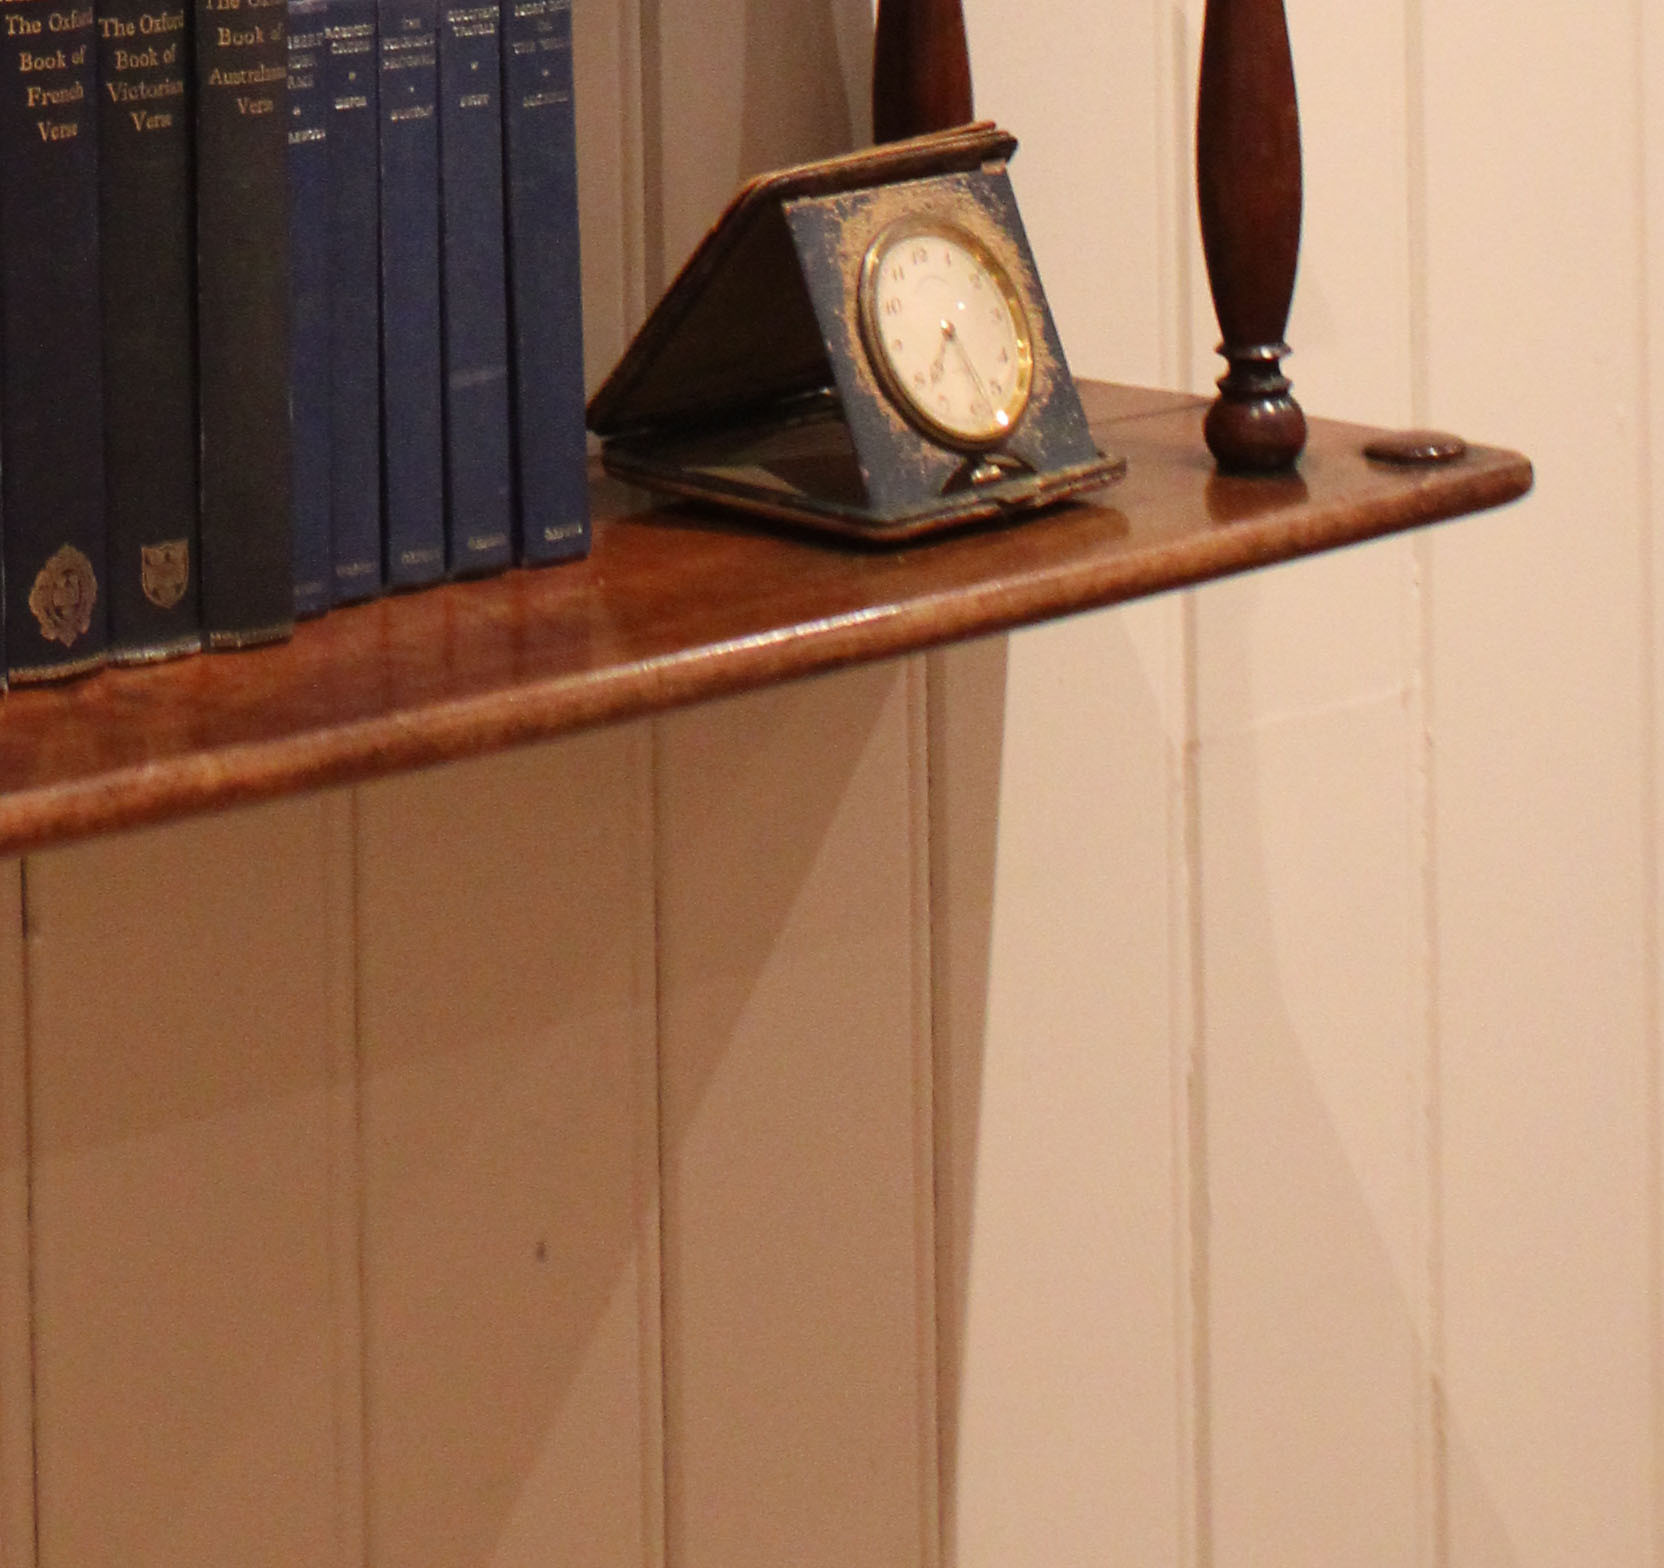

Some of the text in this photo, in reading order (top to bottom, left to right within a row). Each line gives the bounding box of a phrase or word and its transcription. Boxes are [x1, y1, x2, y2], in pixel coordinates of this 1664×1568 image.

[5, 7, 94, 37] The Oxford
[98, 10, 184, 38] The Oxford
[216, 25, 264, 47] Book
[18, 50, 66, 72] Book
[114, 43, 177, 71] Book of
[26, 81, 84, 108] French
[106, 79, 184, 103] Victorian
[38, 121, 78, 143] Verse
[129, 111, 172, 132] Verse
[892, 265, 905, 281] 11
[886, 296, 902, 313] 10
